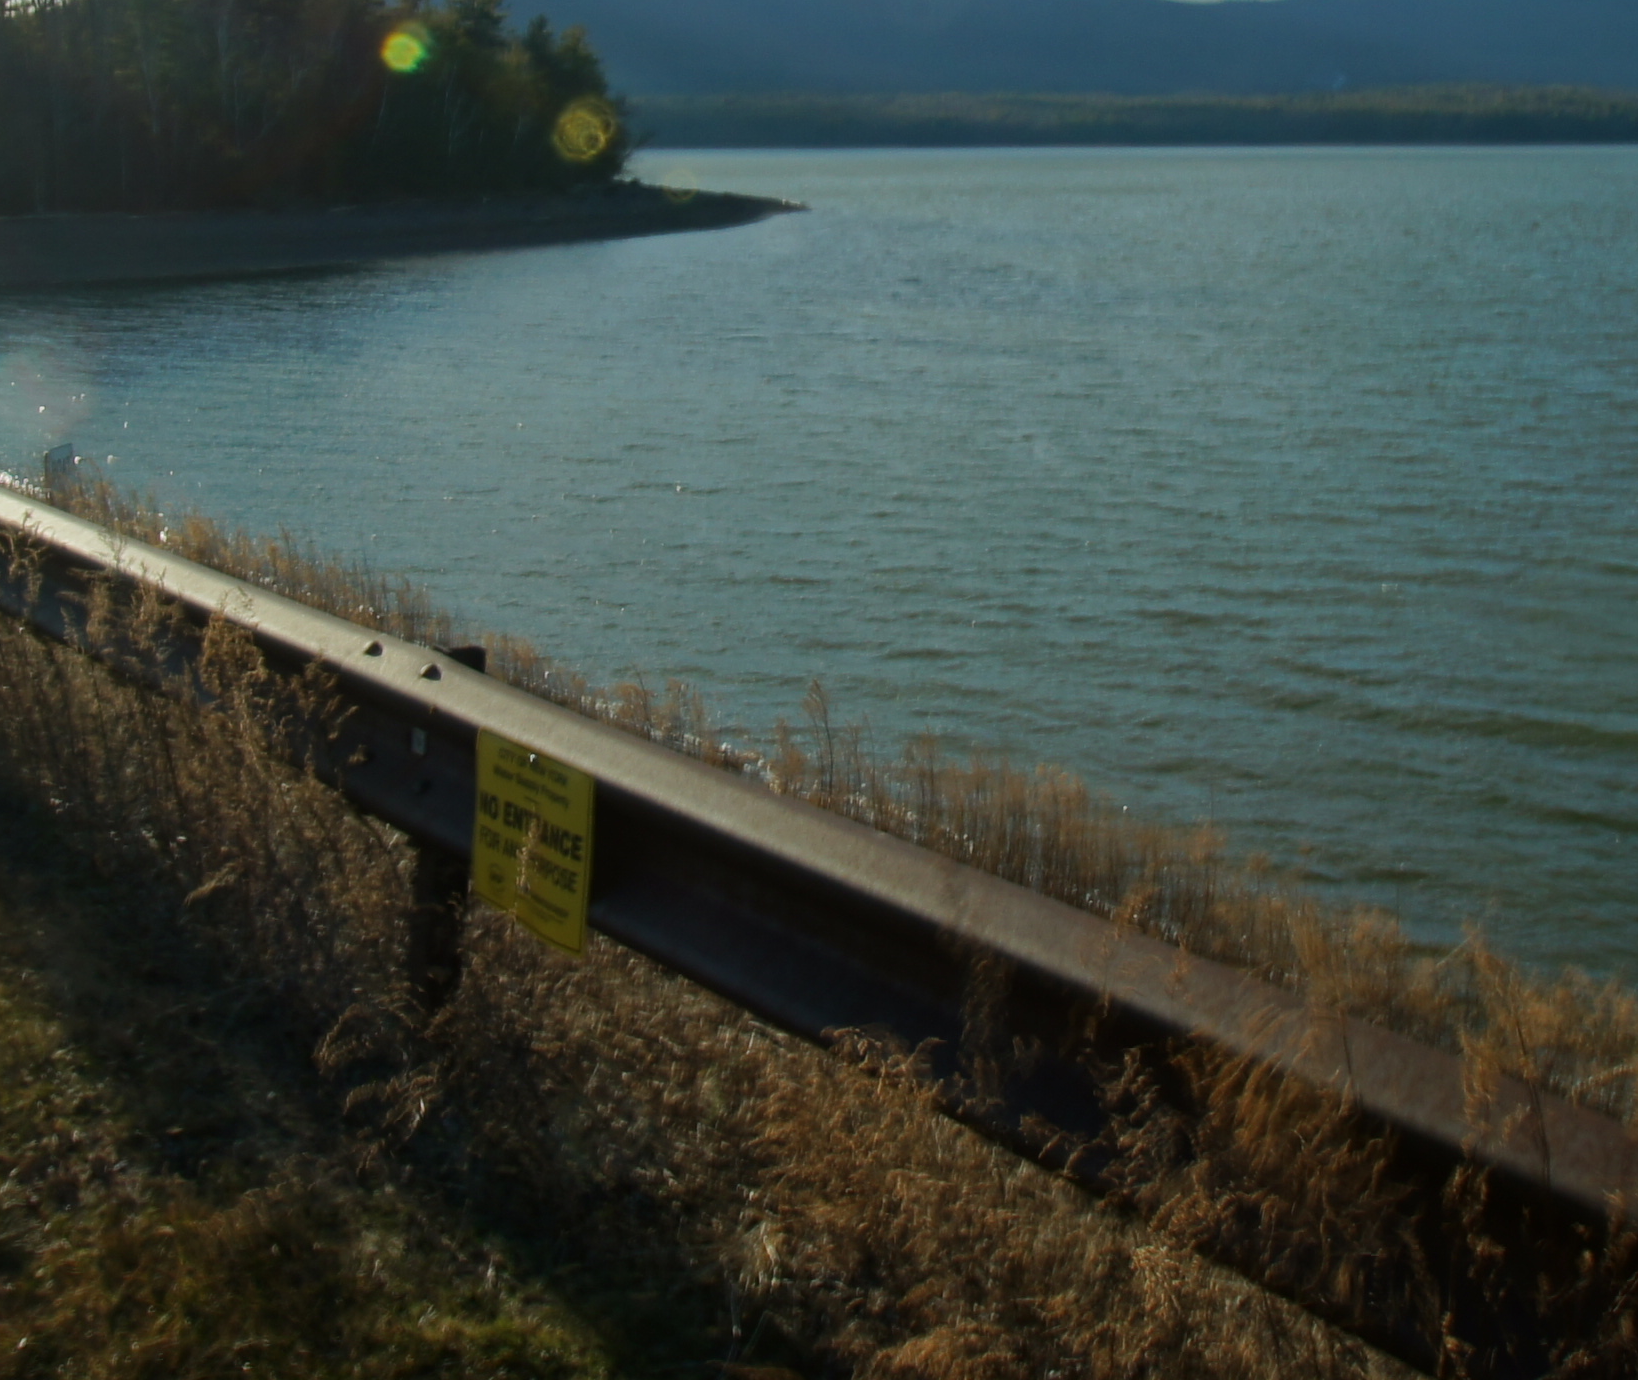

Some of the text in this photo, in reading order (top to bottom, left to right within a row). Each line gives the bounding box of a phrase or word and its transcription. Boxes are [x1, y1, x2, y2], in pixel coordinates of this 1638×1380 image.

[479, 793, 499, 820] NO
[479, 823, 500, 850] FOR
[503, 837, 524, 862] AN
